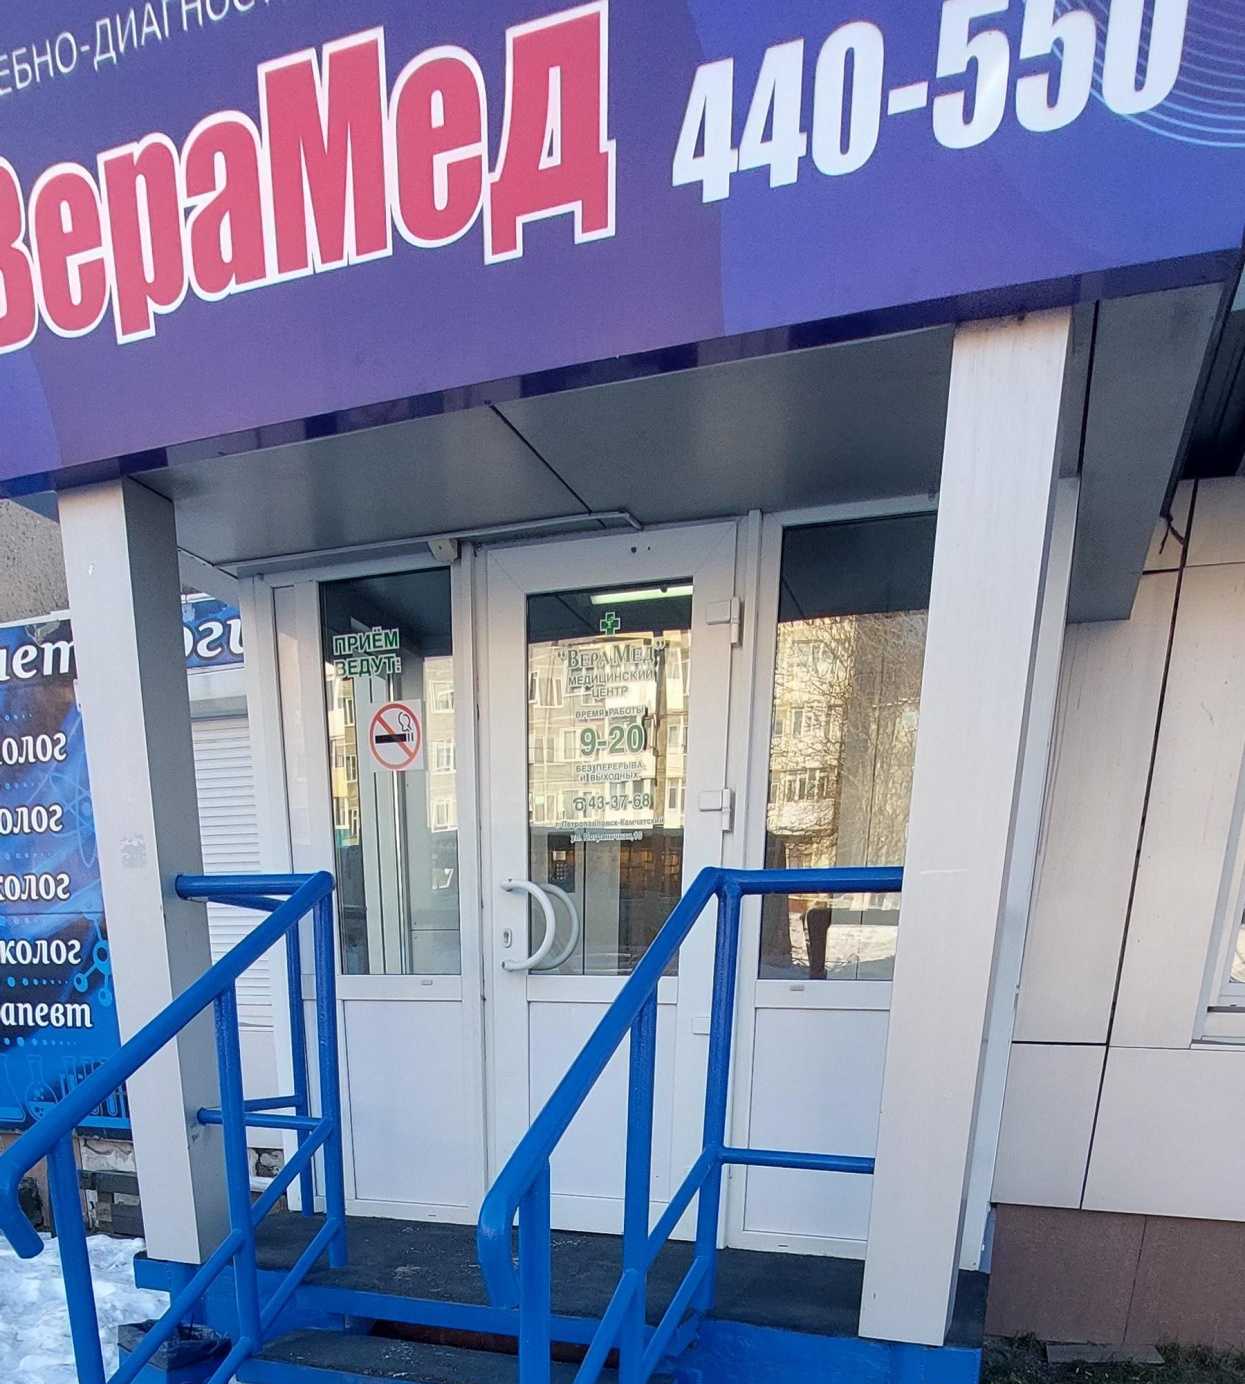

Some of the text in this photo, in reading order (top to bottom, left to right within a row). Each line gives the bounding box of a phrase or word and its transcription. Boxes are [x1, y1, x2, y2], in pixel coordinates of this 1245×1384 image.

[672, 0, 1189, 203] 440-550
[334, 627, 400, 655] ПРИЁМ
[335, 654, 402, 678] ВЕДУТ:
[568, 669, 654, 687] МЕДИЦИНСКИЙ
[592, 685, 628, 699] ЦЕНТР
[609, 705, 644, 717] РАБОТЫ
[0, 732, 68, 765] олог
[580, 724, 645, 756] 9-20
[576, 764, 592, 773] БЕЗ
[589, 793, 650, 810] 43-37-68
[0, 939, 81, 965] колог
[0, 1002, 93, 1028] апевт
